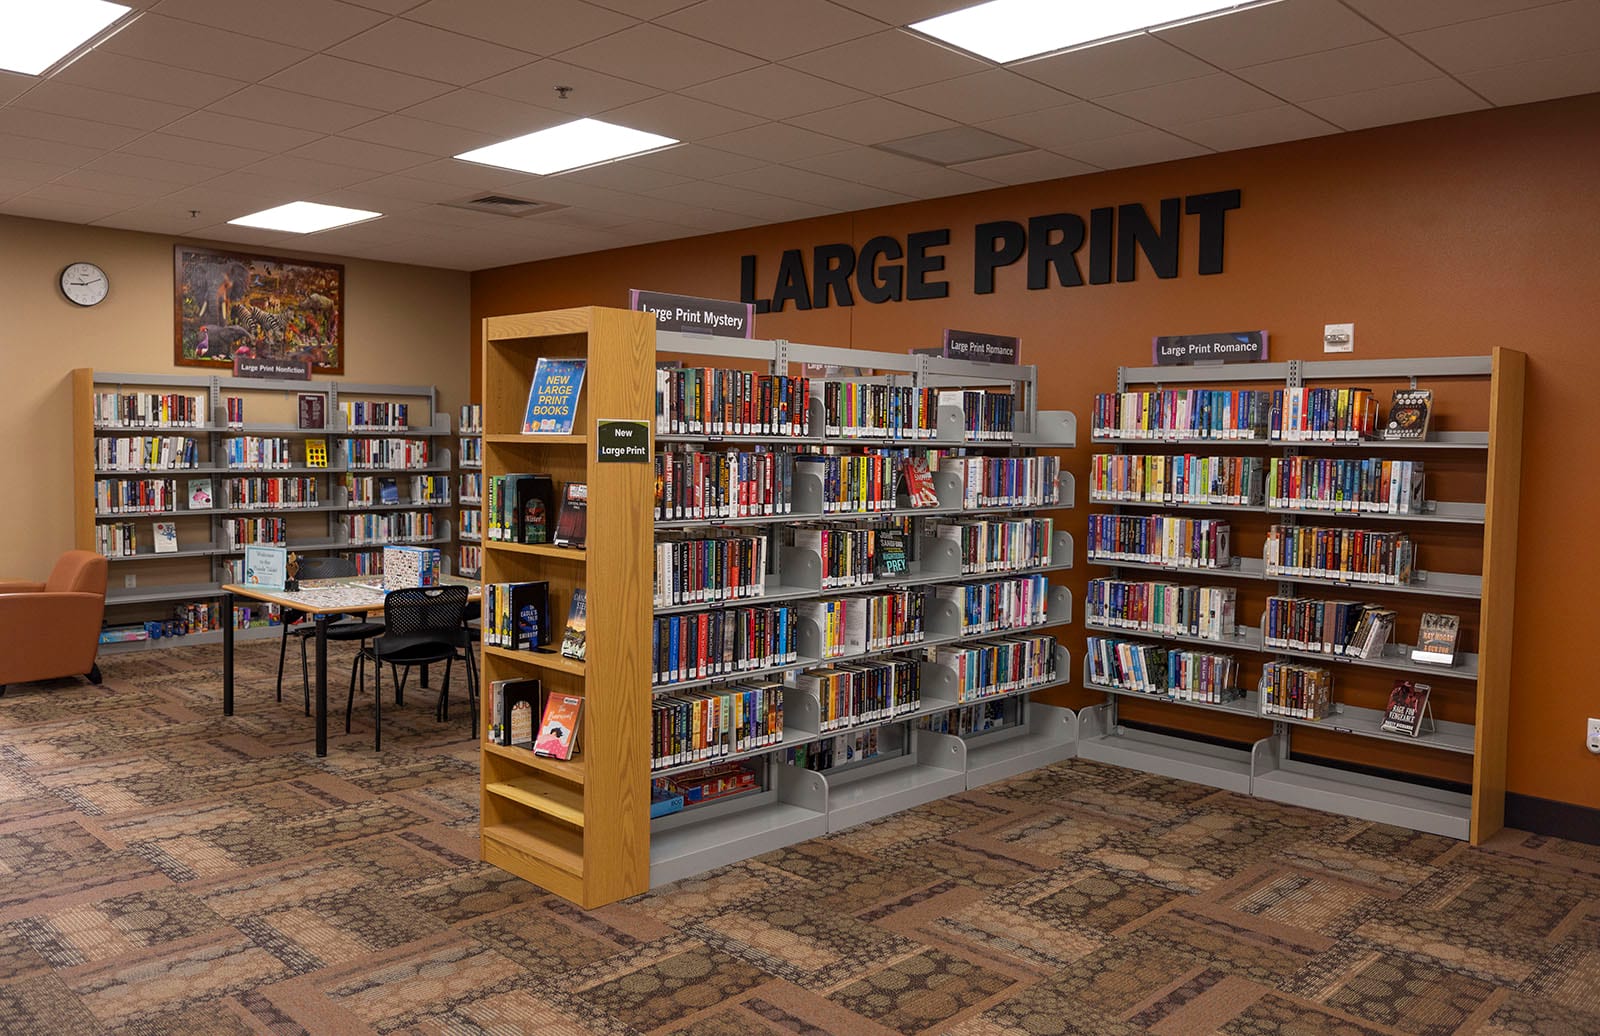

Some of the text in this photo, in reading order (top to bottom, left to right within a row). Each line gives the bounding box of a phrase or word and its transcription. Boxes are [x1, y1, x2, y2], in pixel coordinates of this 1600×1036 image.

[740, 189, 1242, 315] LARGE PRINT
[643, 303, 744, 330] Large Print Mystery
[951, 340, 1014, 356] Large Print Romance
[1161, 340, 1257, 359] Large Print Romance
[241, 363, 305, 374] Large Print Nonfiction
[546, 375, 570, 385] NEW
[538, 385, 573, 395] LARGE
[538, 395, 569, 405] PRINT
[533, 404, 569, 416] BOOKS
[614, 428, 633, 438] New
[602, 445, 646, 456] Large Print
[886, 560, 907, 573] PREY
[1388, 711, 1416, 724] VENGEANCE
